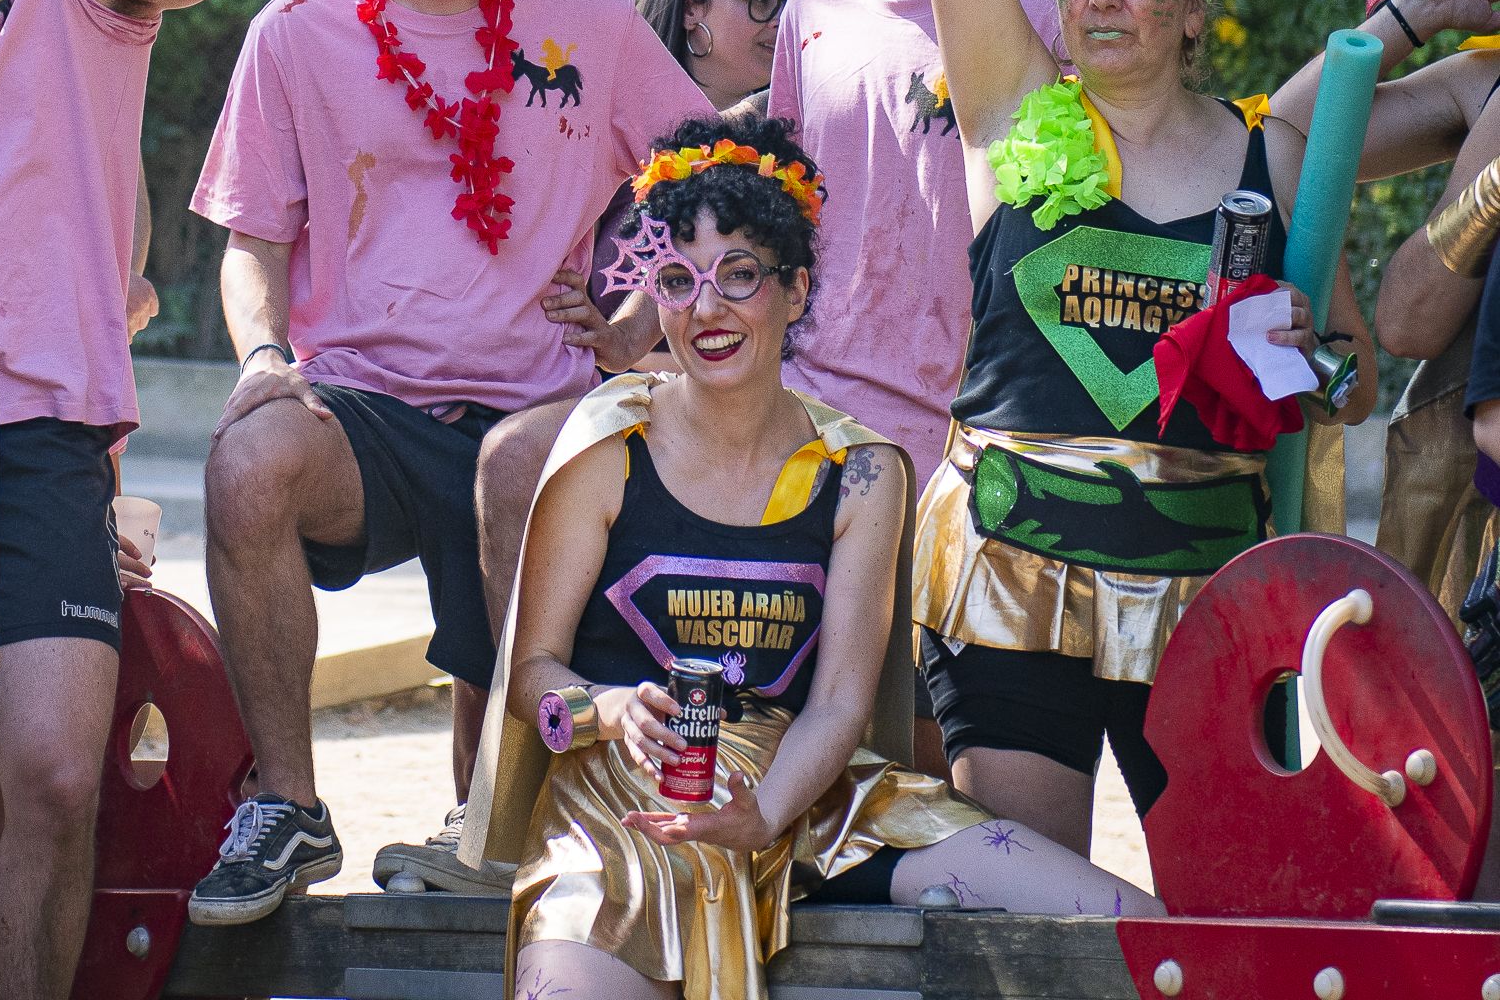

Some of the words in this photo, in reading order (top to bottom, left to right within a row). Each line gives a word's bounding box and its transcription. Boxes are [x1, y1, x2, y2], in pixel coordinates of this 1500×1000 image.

[1063, 295, 1191, 334] AQUAGY
[667, 589, 735, 617] MUJER
[740, 590, 806, 623] ARAÑA
[676, 619, 795, 650] VASCULAR
[677, 703, 720, 721] strella
[669, 717, 718, 738] Galicia
[681, 753, 708, 765] special
